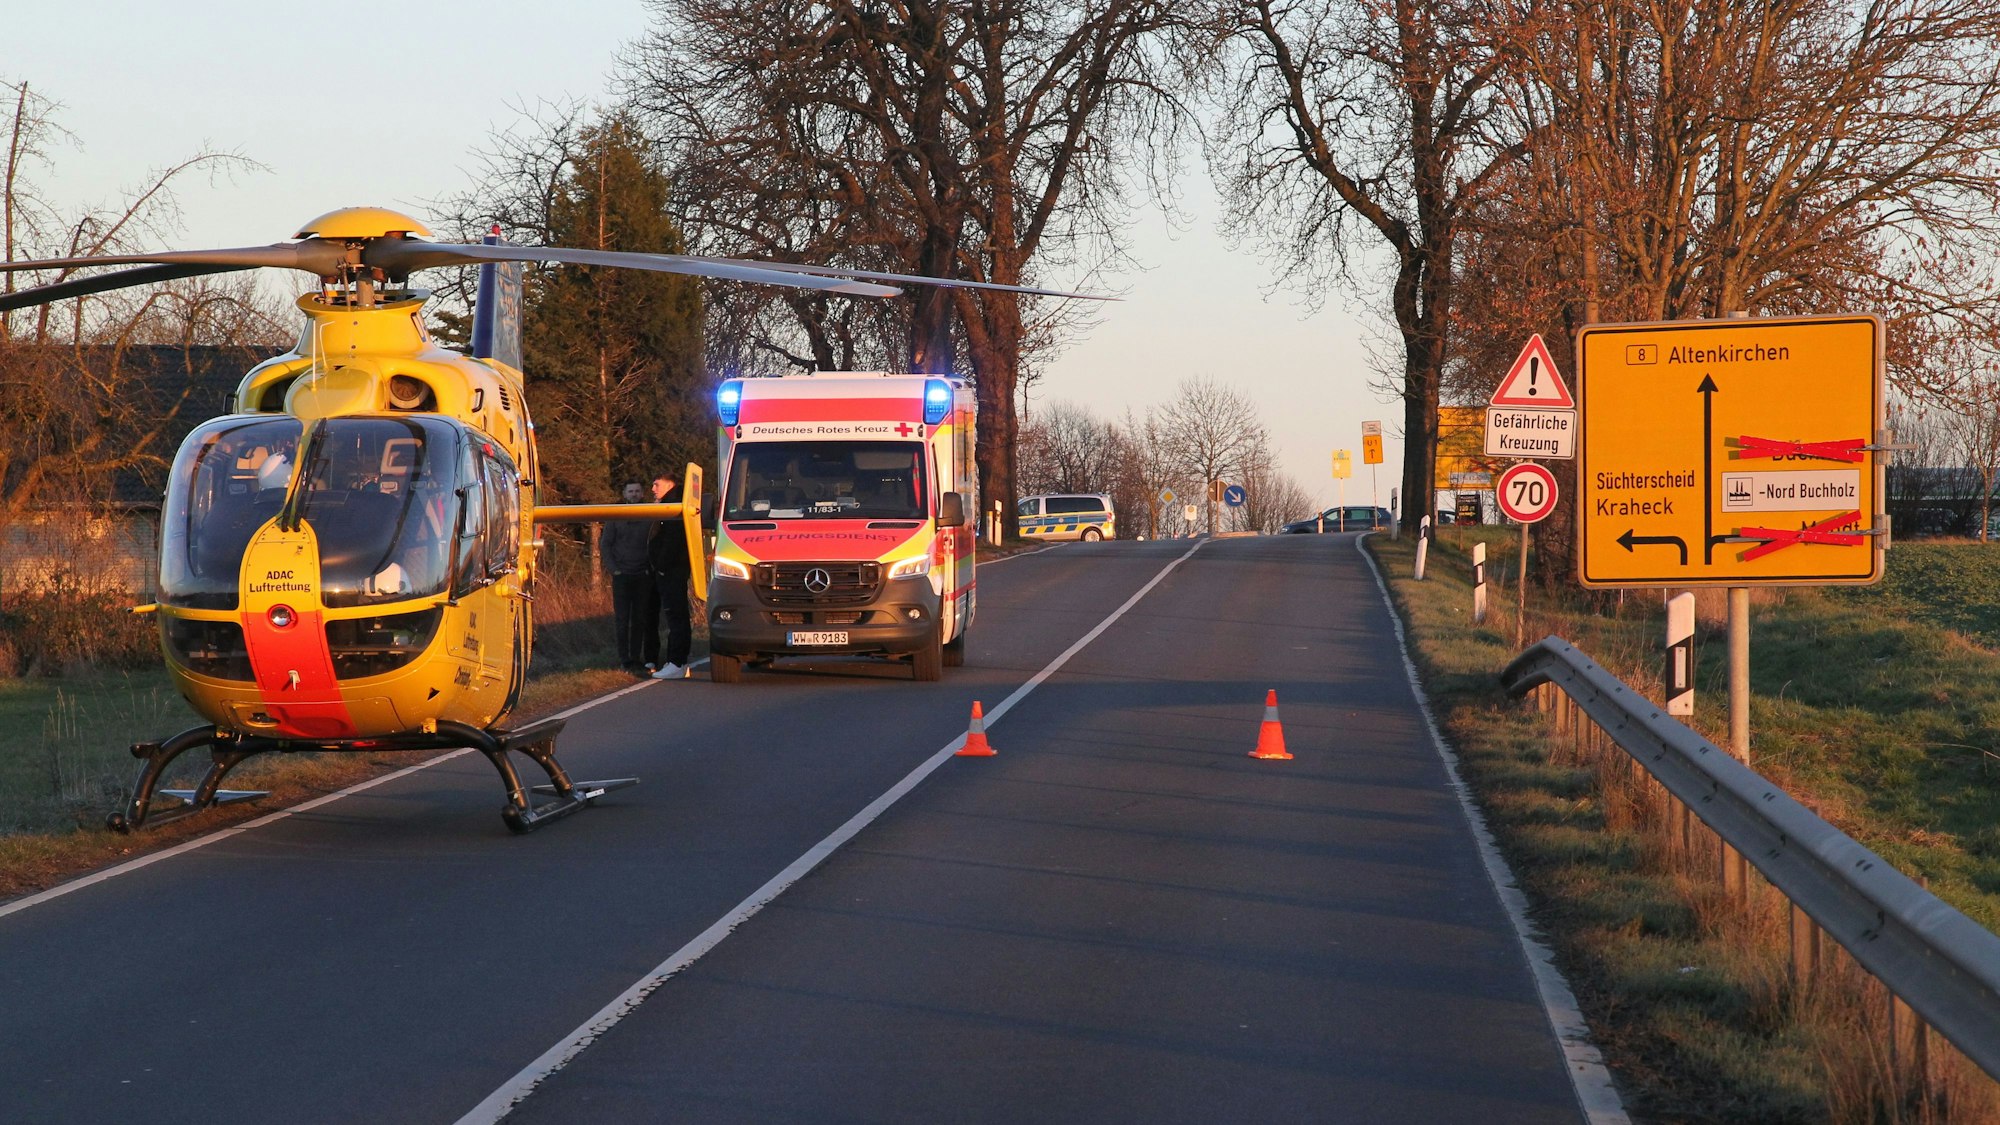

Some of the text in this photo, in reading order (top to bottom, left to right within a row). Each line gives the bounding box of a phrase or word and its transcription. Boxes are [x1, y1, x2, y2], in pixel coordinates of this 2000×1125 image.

[1637, 344, 1789, 364] 8 Altenkirchen
[752, 425, 889, 434] Deutsches Rotes Kreuz
[1494, 413, 1568, 430] Gefährliche
[1500, 434, 1559, 454] Kreuzung
[1596, 470, 1695, 490] Süchterscheid
[1512, 481, 1544, 507] 70
[1800, 482, 1855, 498] Buchholz
[1596, 497, 1674, 516] Kraheck
[743, 533, 898, 544] RETTUNGSDIENST
[266, 570, 294, 580] ADAC
[249, 582, 311, 593] Luftrettung
[821, 633, 847, 643] 9183
